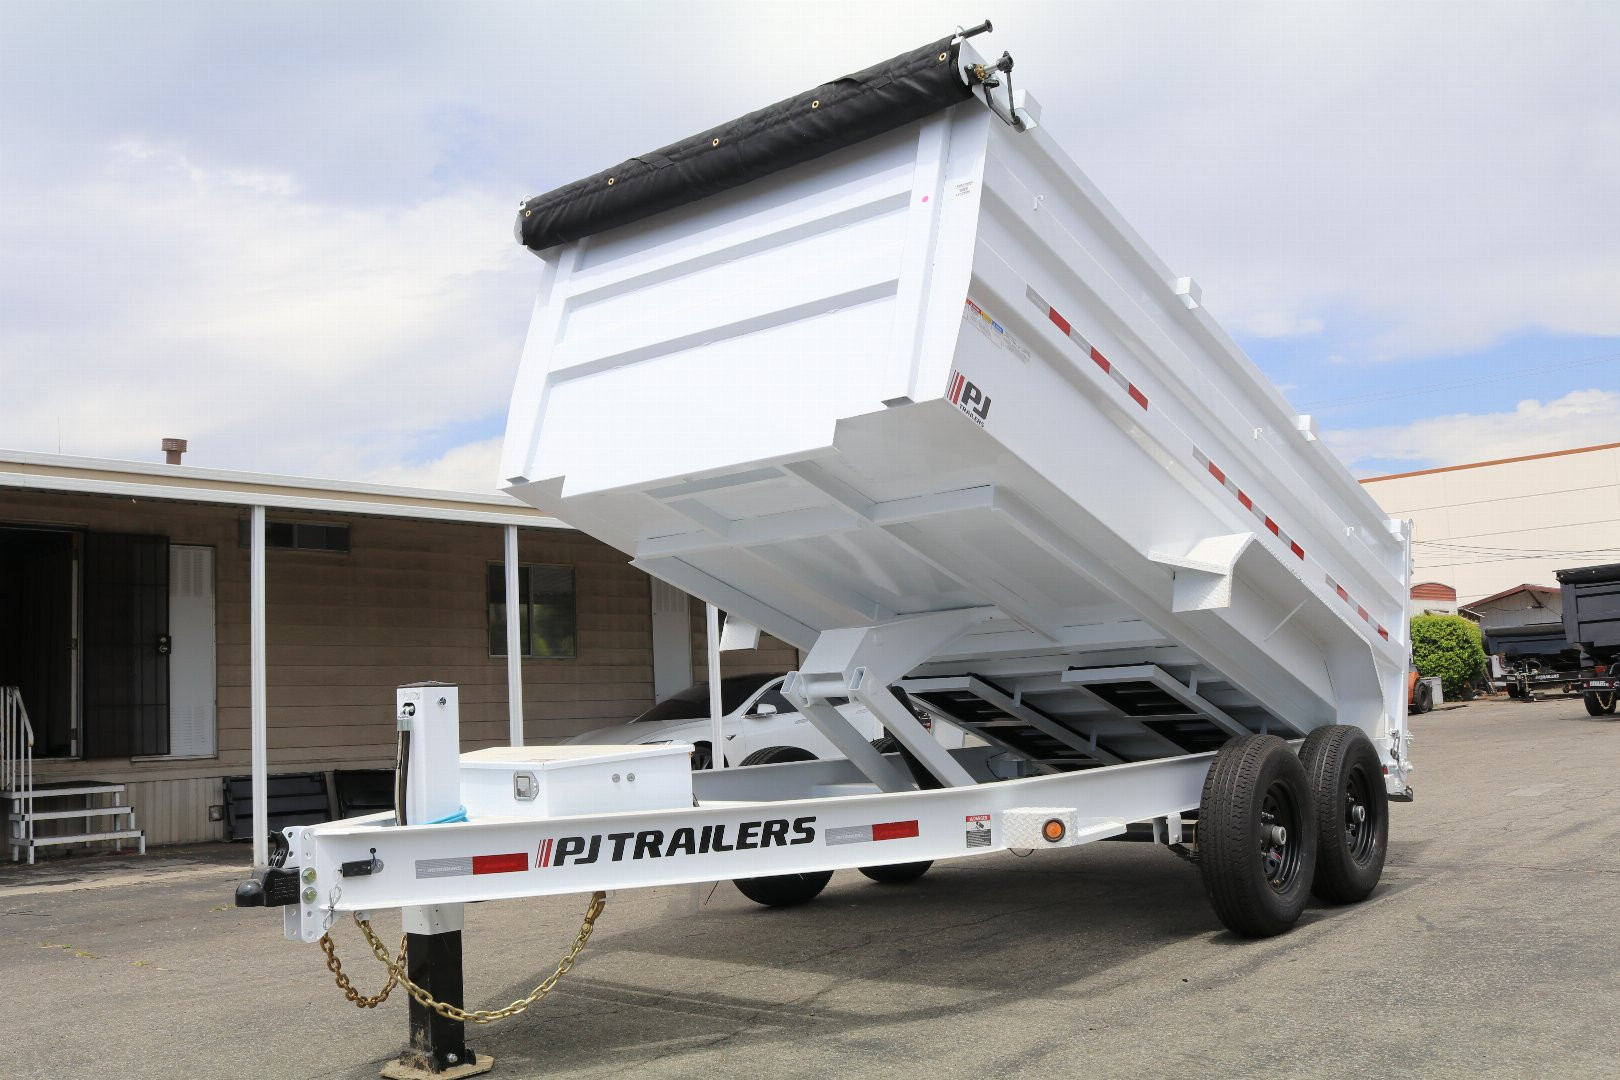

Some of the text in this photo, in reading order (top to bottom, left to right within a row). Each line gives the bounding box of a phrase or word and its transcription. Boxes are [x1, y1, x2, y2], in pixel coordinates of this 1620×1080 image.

[960, 404, 984, 428] TRAILERS
[961, 381, 992, 420] PJ
[553, 816, 817, 867] PJ TRAILERS
